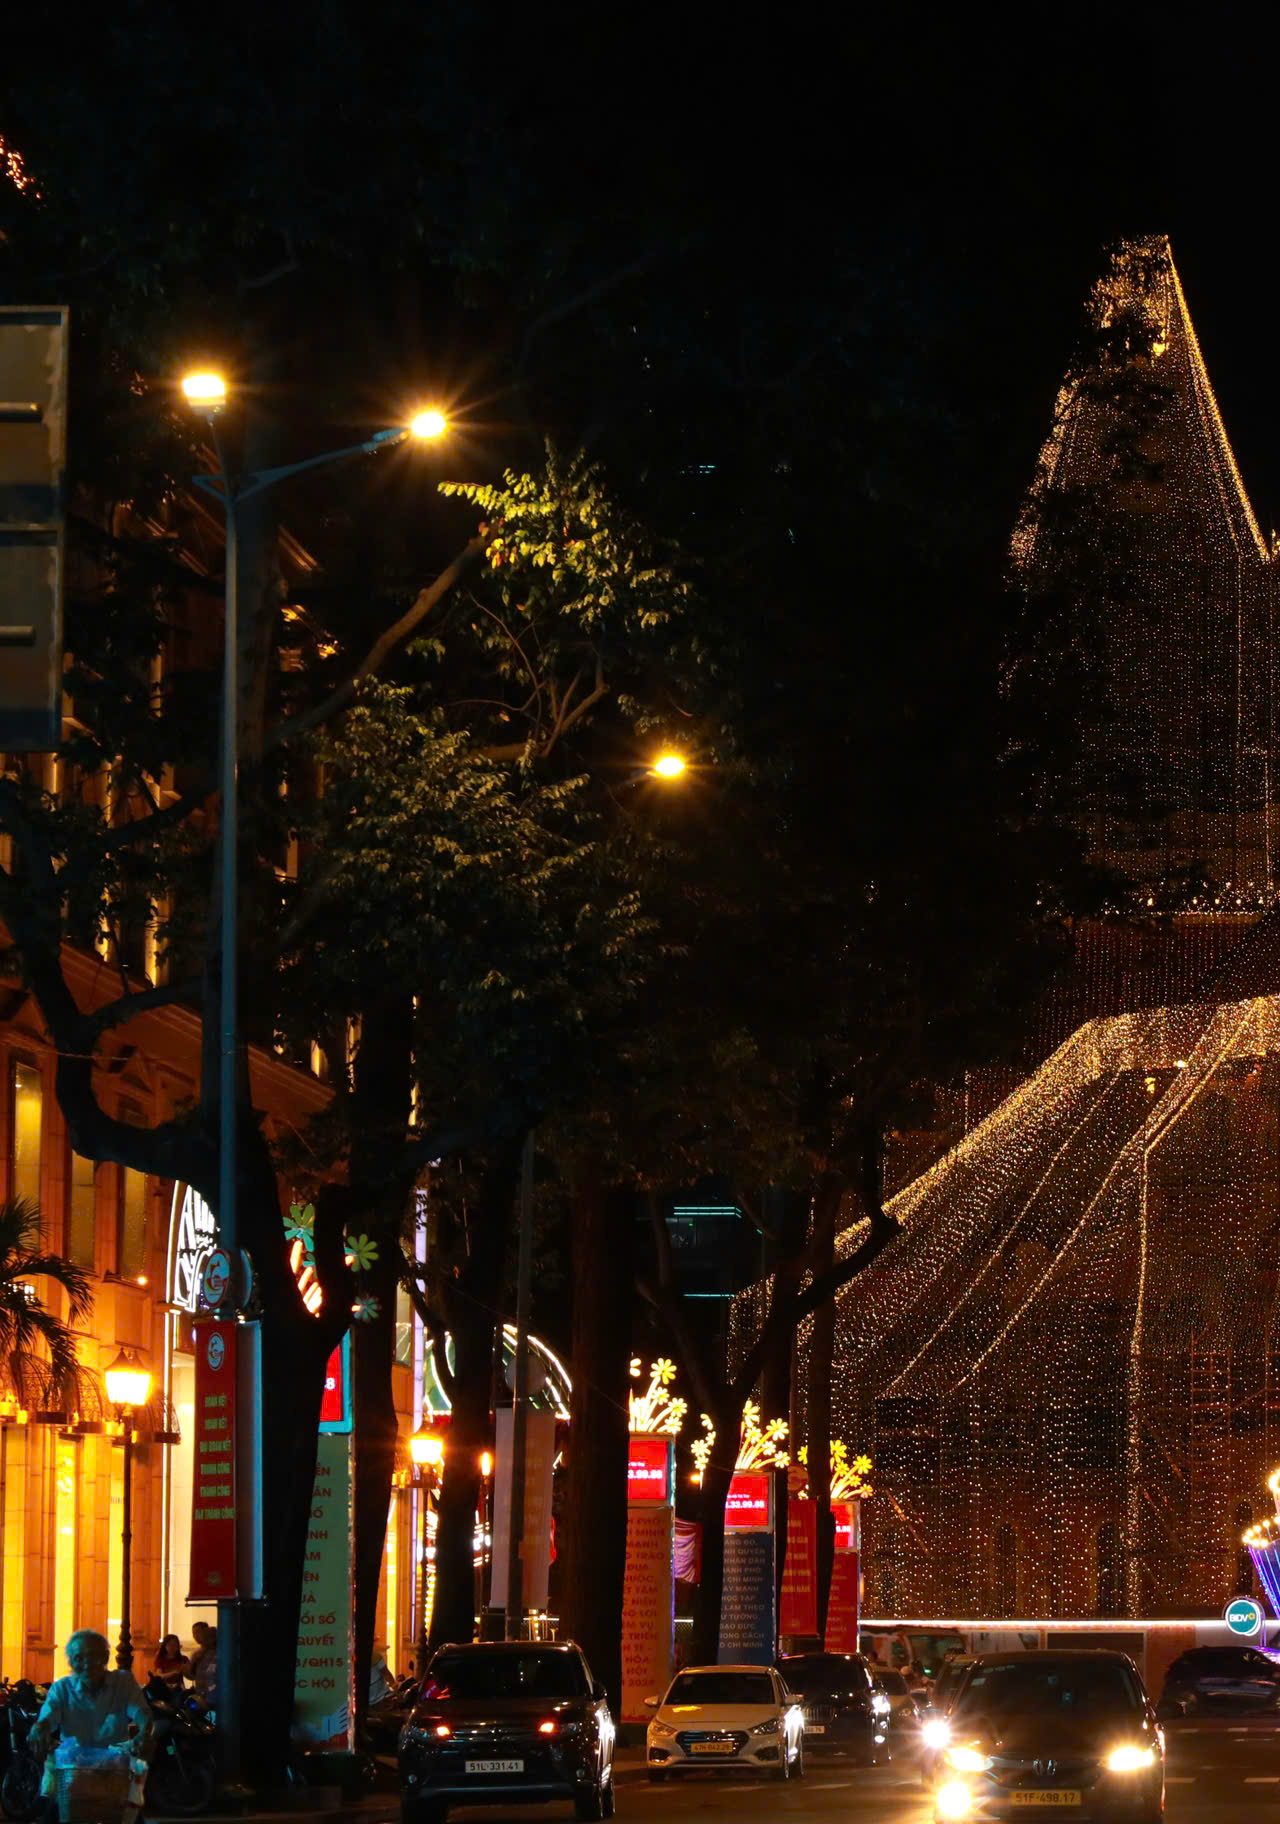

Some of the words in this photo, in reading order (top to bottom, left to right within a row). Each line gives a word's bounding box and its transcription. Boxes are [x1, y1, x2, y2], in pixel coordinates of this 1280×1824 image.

[319, 1611, 337, 1625] SỐ
[1229, 1613, 1249, 1623] BIDV
[312, 1677, 335, 1691] HỘI
